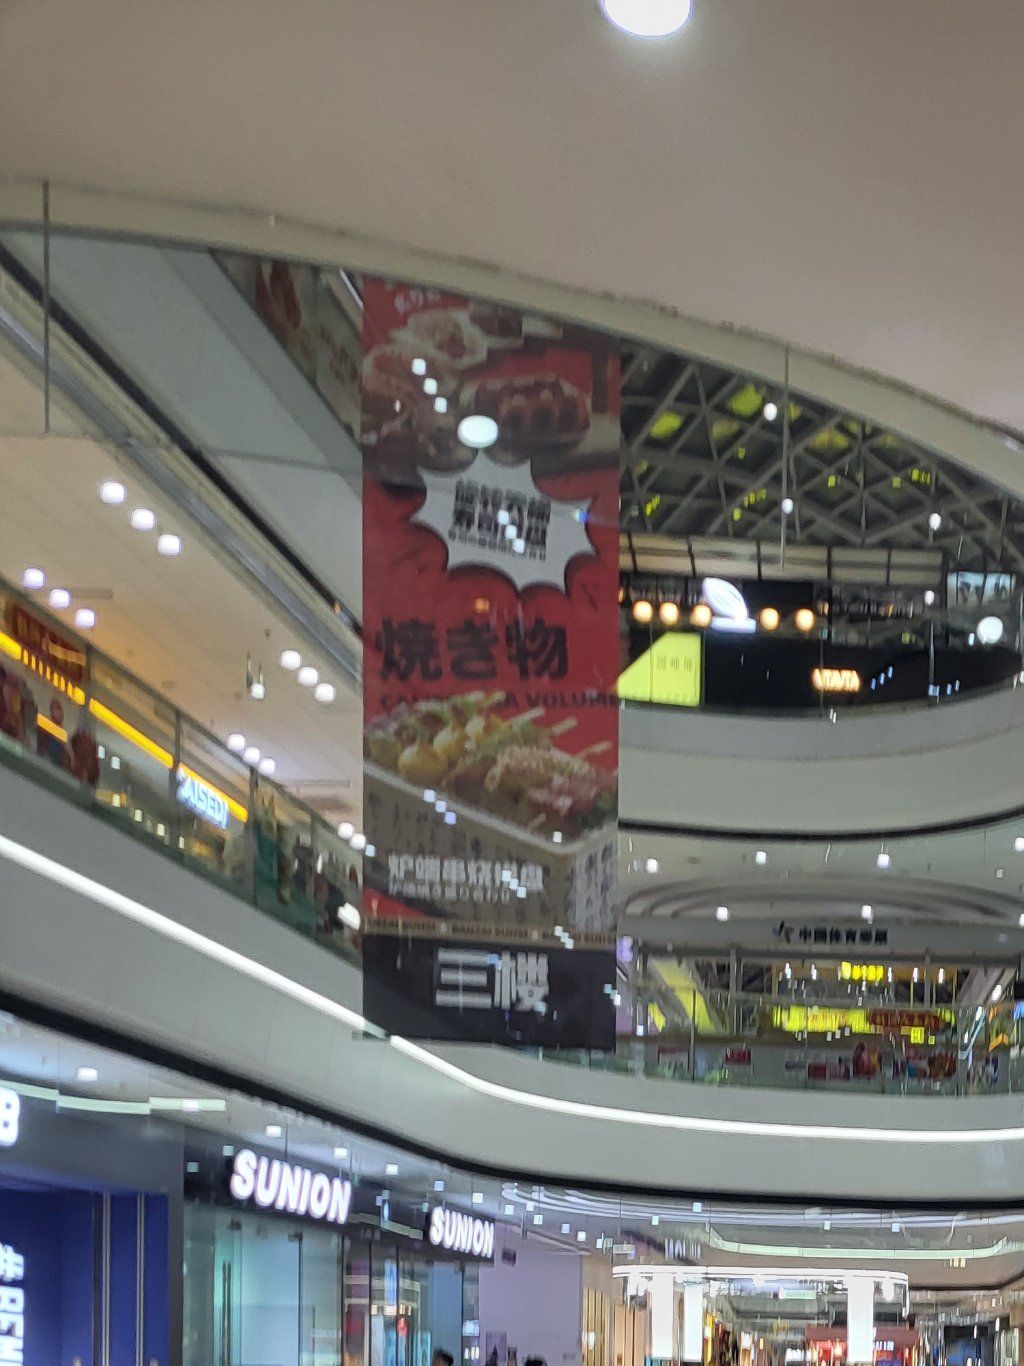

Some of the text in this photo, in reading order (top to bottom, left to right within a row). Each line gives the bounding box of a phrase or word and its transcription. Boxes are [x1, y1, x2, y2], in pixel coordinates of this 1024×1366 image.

[436, 949, 549, 1010] 三楼
[230, 1149, 352, 1224] SUNION
[430, 1206, 494, 1258] SUNION
